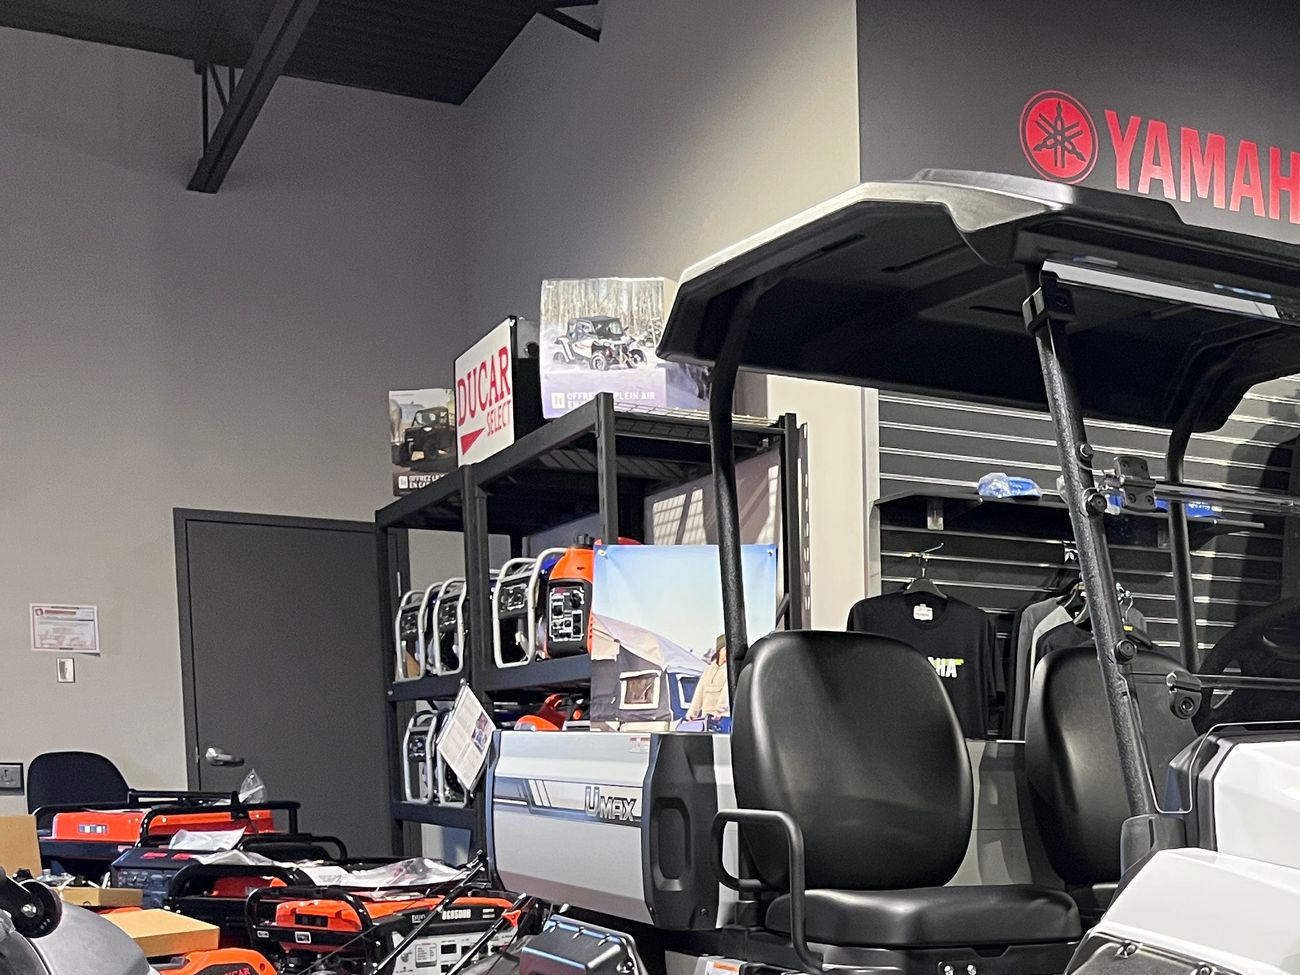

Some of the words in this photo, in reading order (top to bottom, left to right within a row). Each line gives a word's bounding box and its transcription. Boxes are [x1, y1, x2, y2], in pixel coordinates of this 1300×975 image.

[455, 345, 511, 427] DUCAR
[640, 391, 655, 400] AIR
[487, 399, 512, 437] SELECT
